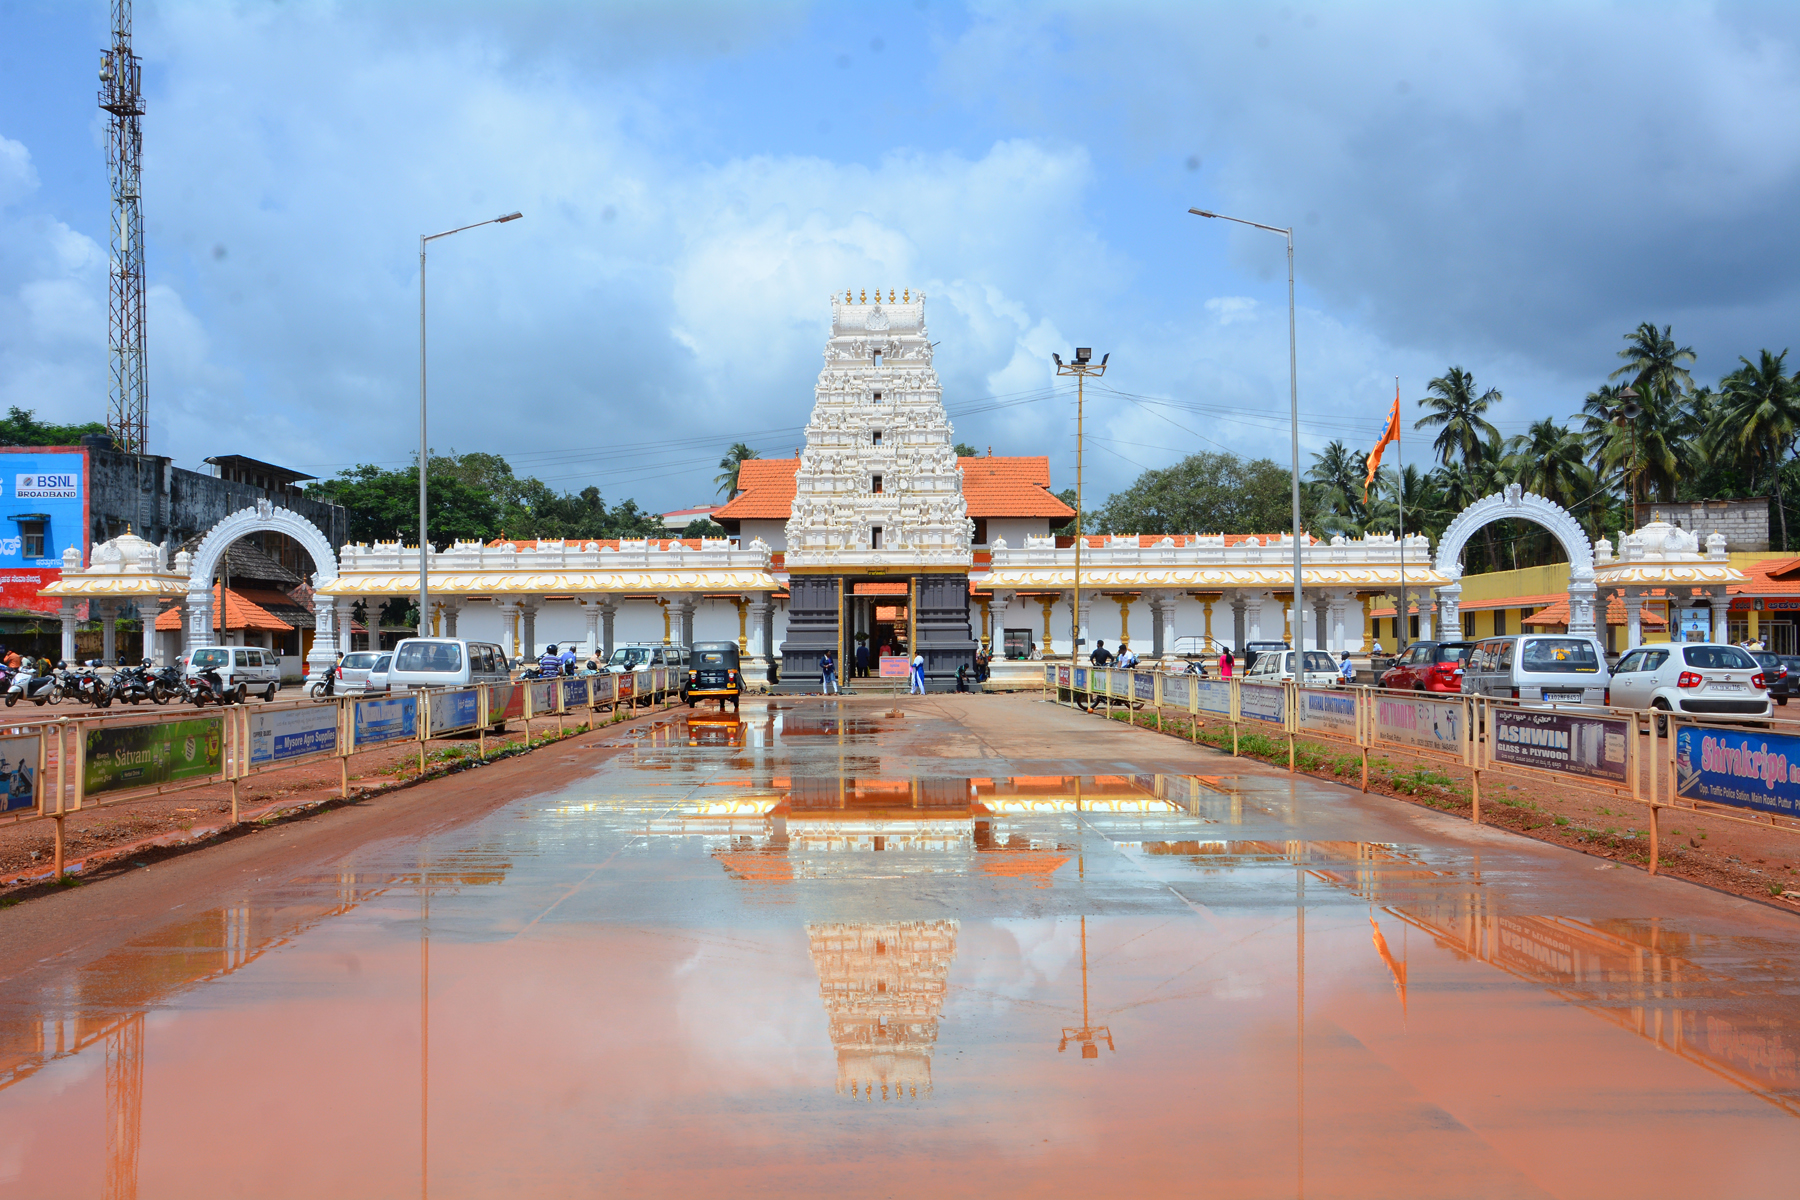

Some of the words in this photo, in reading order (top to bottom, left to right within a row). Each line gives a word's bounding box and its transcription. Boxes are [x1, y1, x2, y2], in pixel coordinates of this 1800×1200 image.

[37, 475, 75, 488] BSNL
[17, 490, 77, 498] BROADBAND
[1389, 702, 1417, 731] TRADERS
[284, 735, 304, 750] Mysore
[304, 733, 315, 746] Agro
[315, 730, 336, 743] Supplies
[1498, 724, 1569, 750] ASHWIN
[115, 748, 151, 767] Satvam
[1497, 743, 1520, 754] GLASS
[1530, 748, 1569, 761] PLYWOOD
[1701, 735, 1788, 790] Shivakripa
[1699, 782, 1710, 796] Opp.
[1710, 784, 1723, 797] Traffic
[1723, 787, 1736, 799] Police
[1751, 791, 1763, 804] Main
[1763, 793, 1777, 808] Road,
[1778, 796, 1793, 809] Puttur
